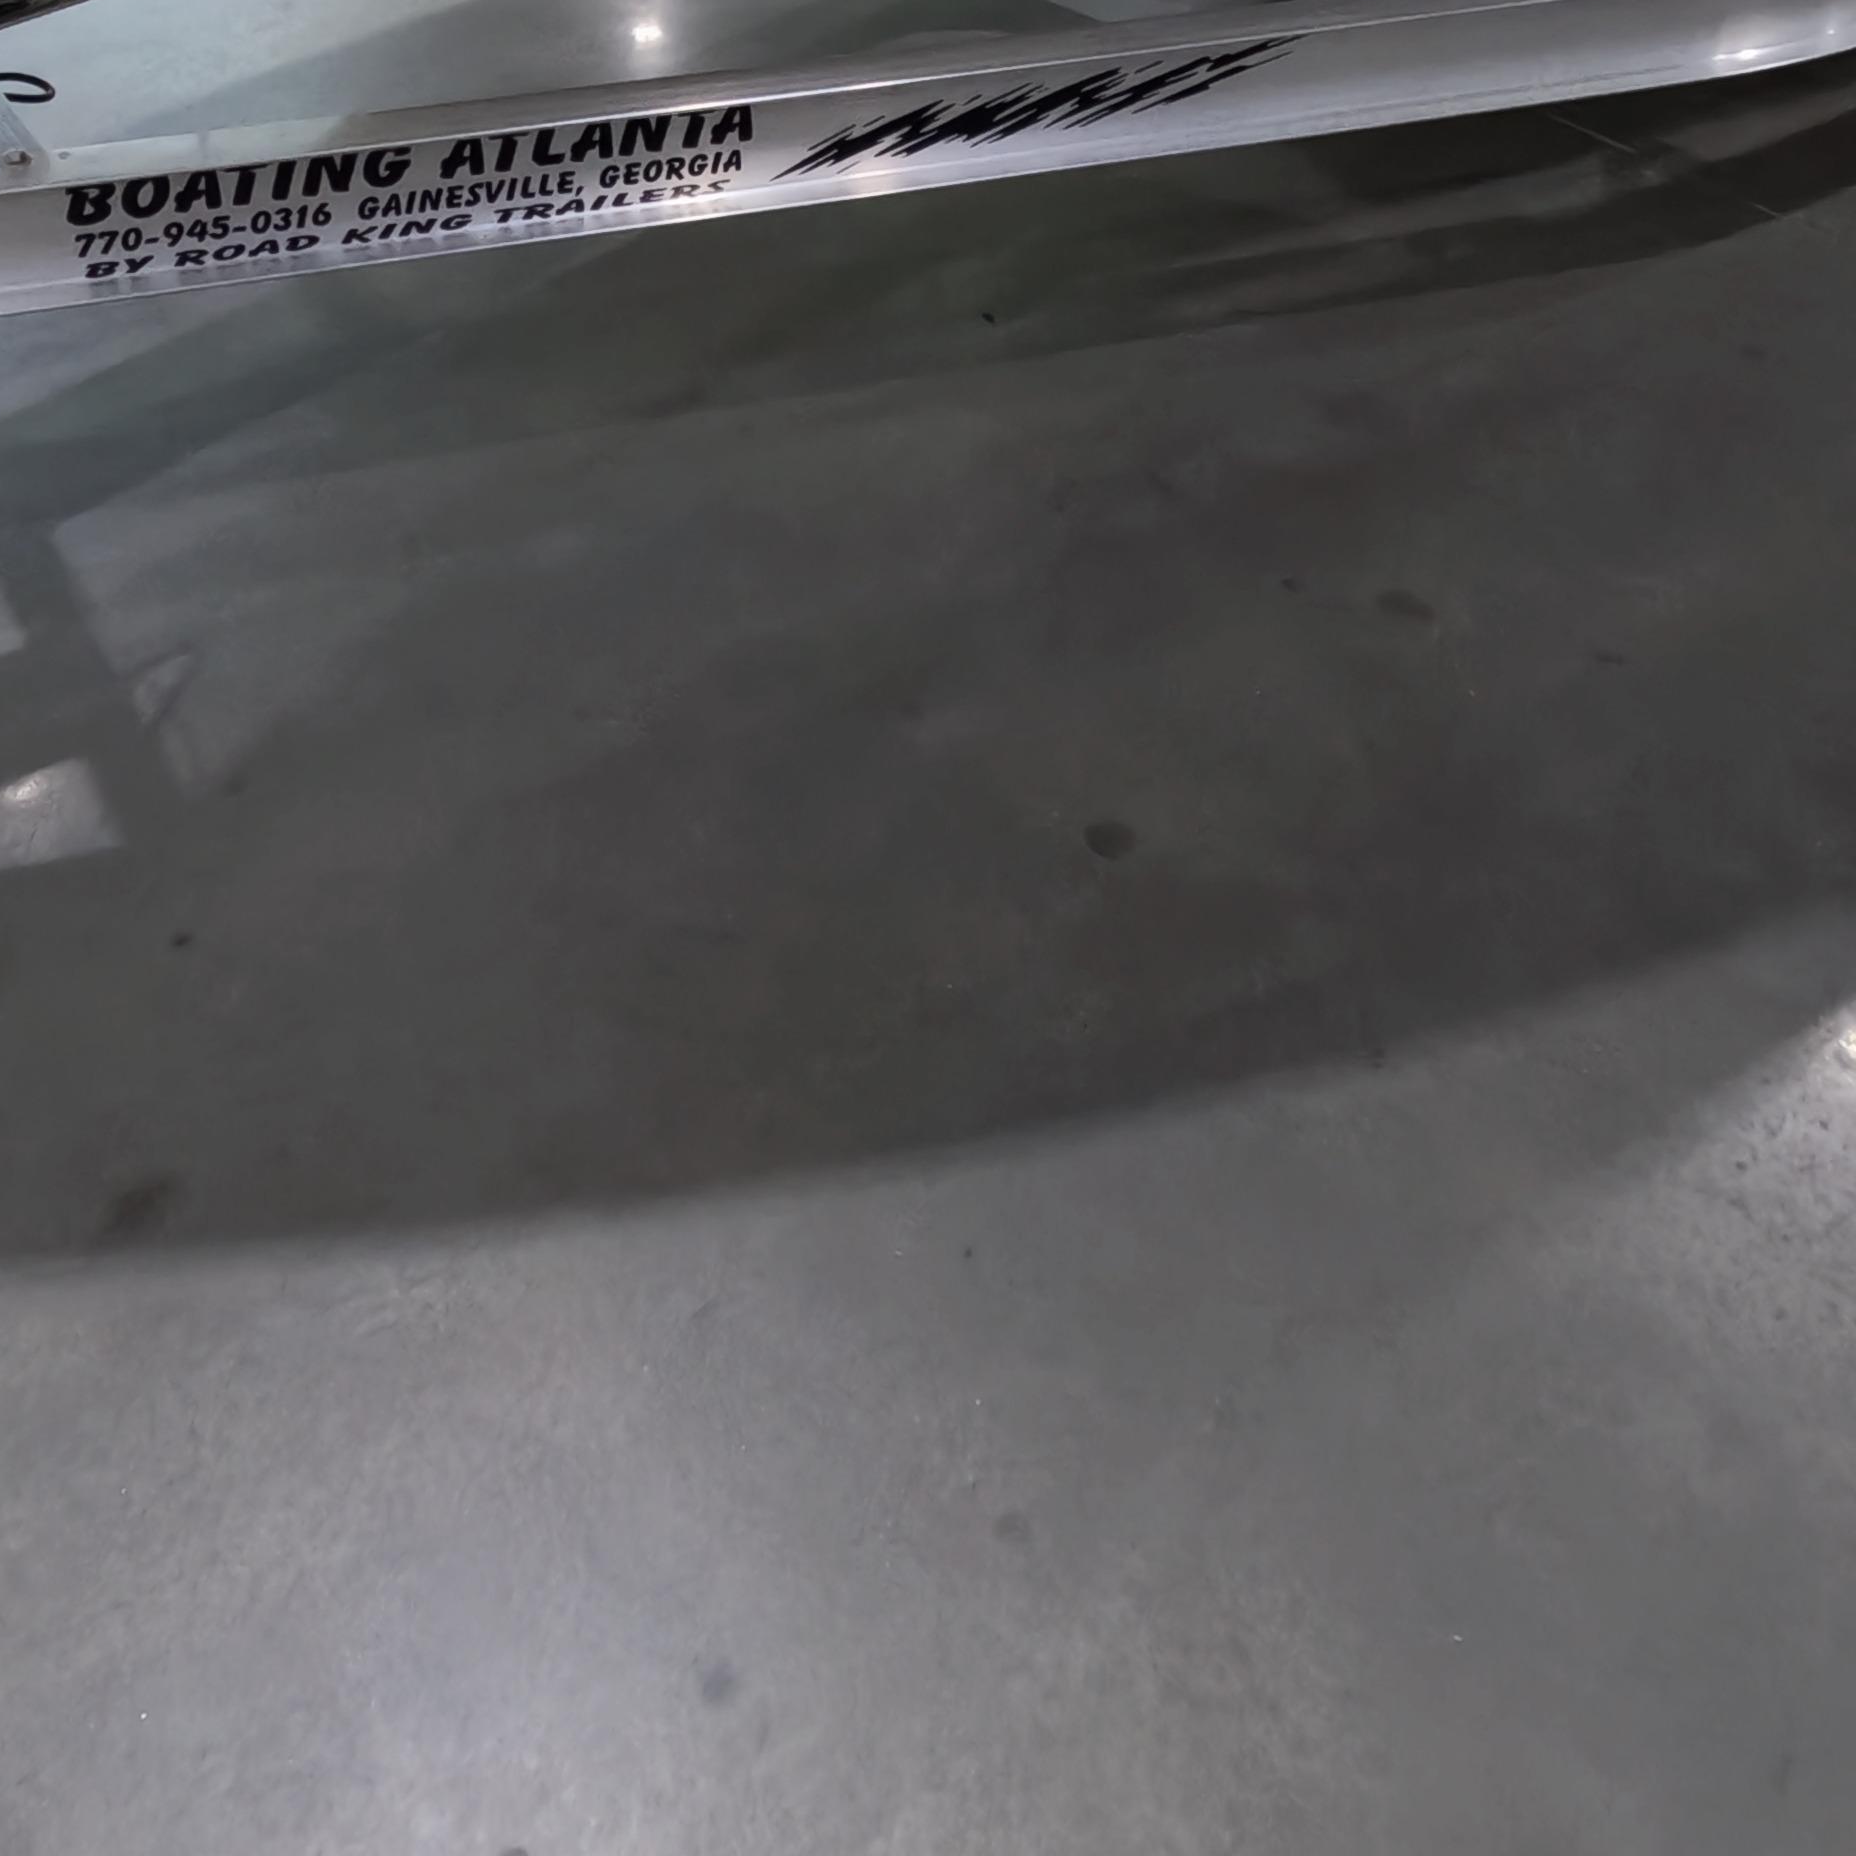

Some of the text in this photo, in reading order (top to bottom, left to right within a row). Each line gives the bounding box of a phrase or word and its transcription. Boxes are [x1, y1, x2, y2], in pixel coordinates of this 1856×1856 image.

[64, 104, 754, 227] BOATING ATLANTA
[73, 148, 743, 259] 770-945-0316 GAINESVILLE, GEORGIA
[84, 178, 732, 280] BY ROAD KING TRAILERS
